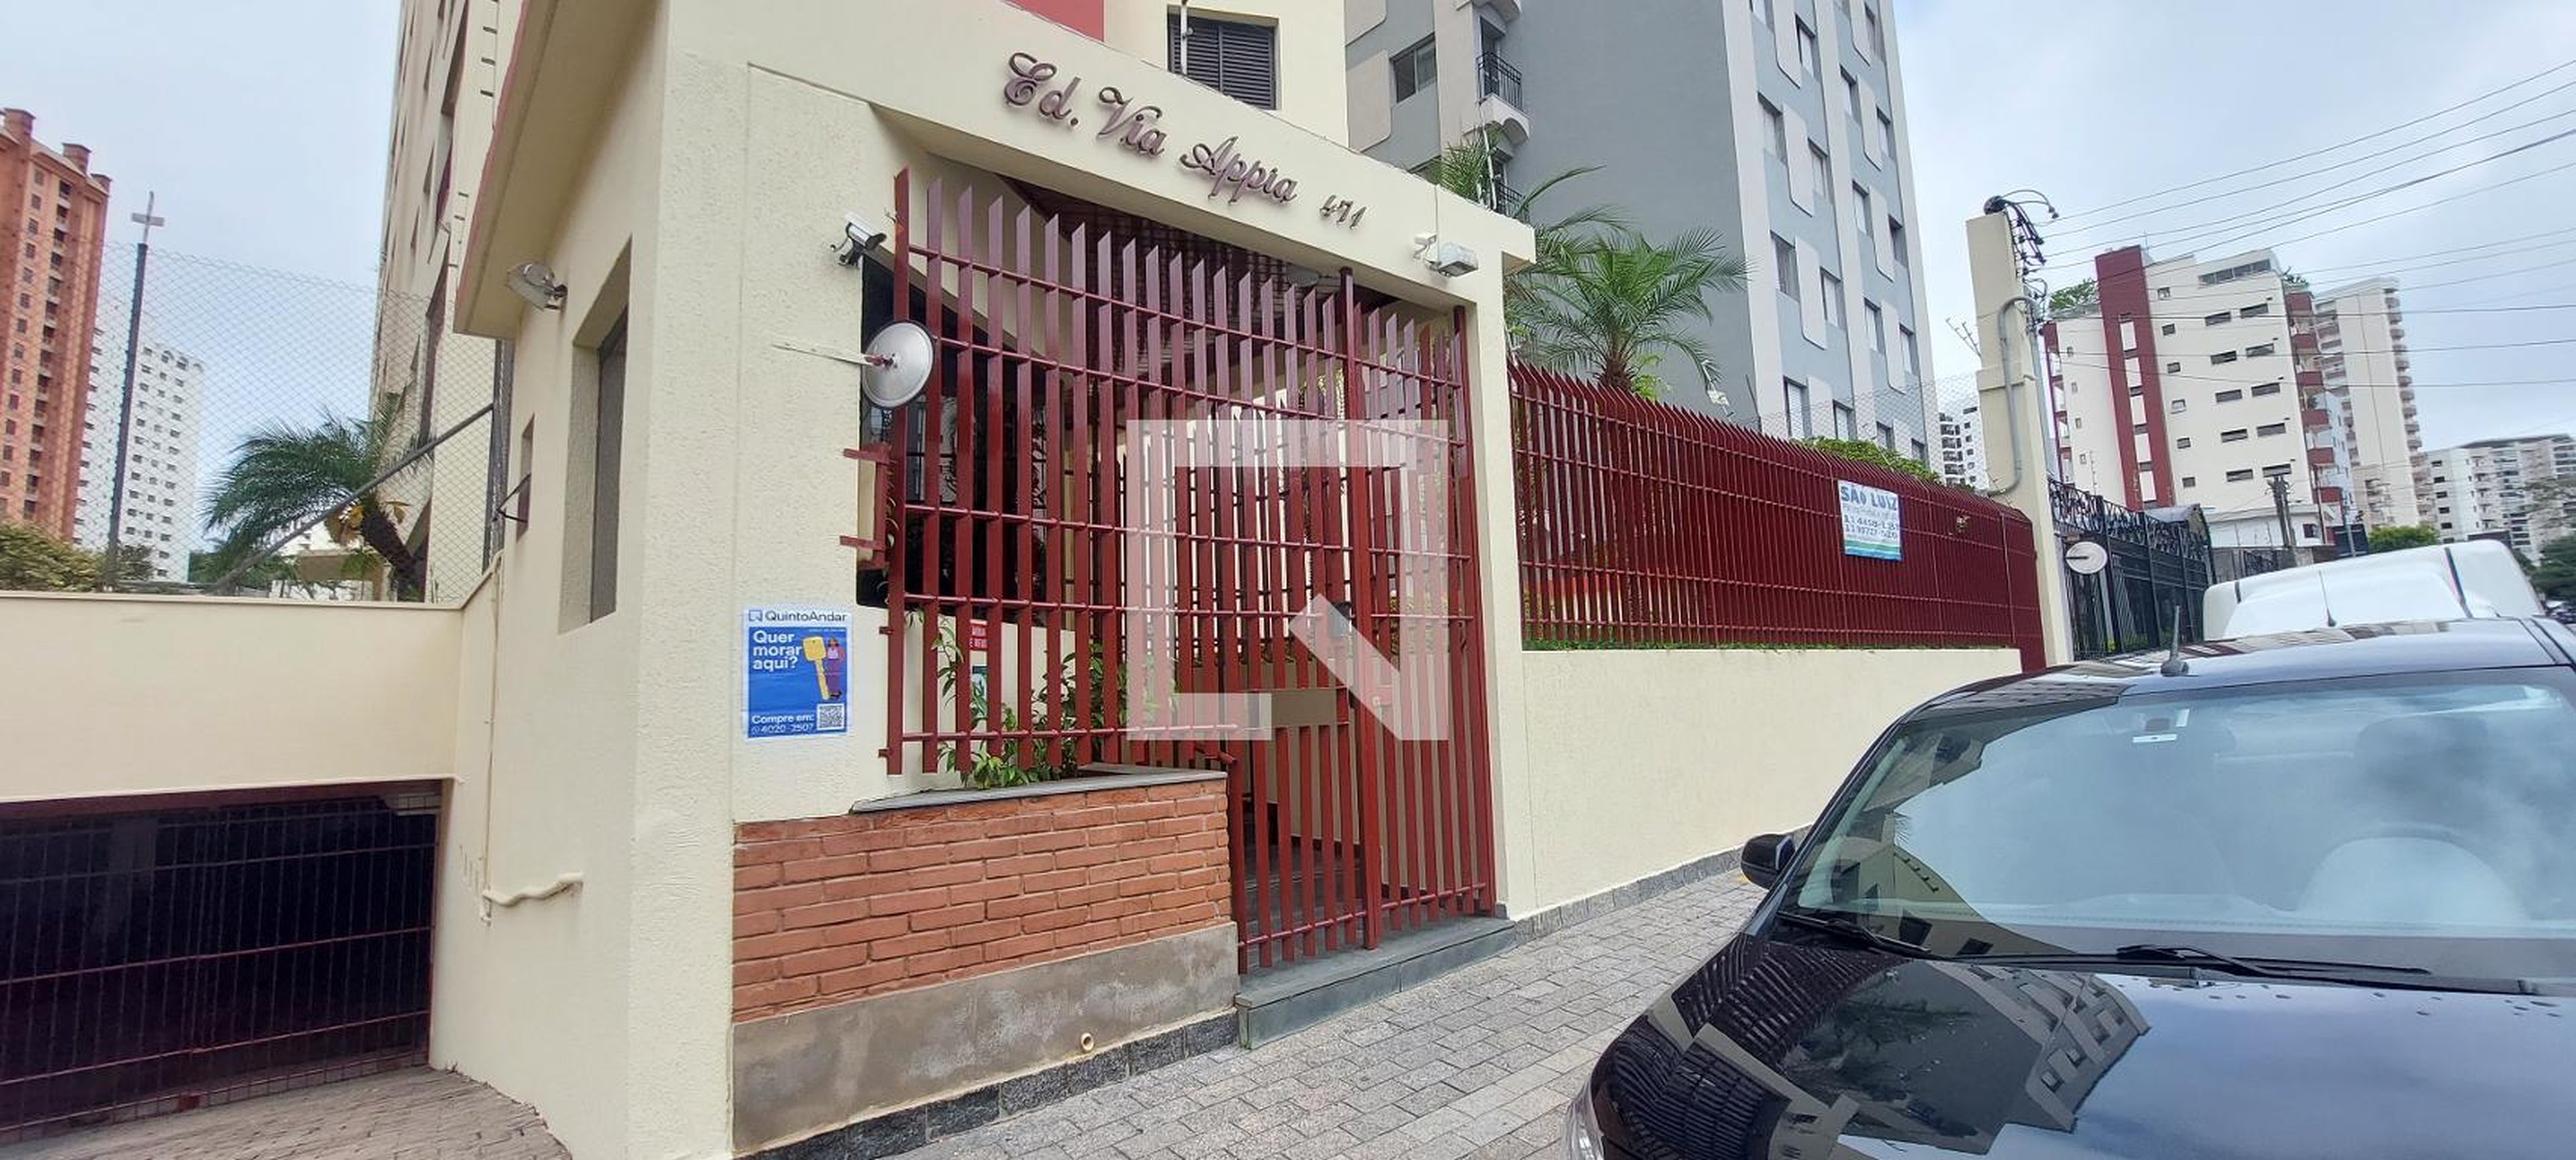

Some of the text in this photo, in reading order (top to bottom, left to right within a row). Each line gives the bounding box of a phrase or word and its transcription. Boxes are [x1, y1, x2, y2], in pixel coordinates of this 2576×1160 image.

[1096, 86, 1168, 158] Via
[1179, 135, 1299, 205] Appia
[1319, 195, 1367, 229] 471
[1870, 492, 1898, 511] LUIZ
[765, 610, 847, 622] QuintoAndar
[753, 630, 795, 643] Quer
[753, 646, 802, 657] morar
[752, 656, 798, 672] aqui?
[751, 715, 794, 725] Compre
